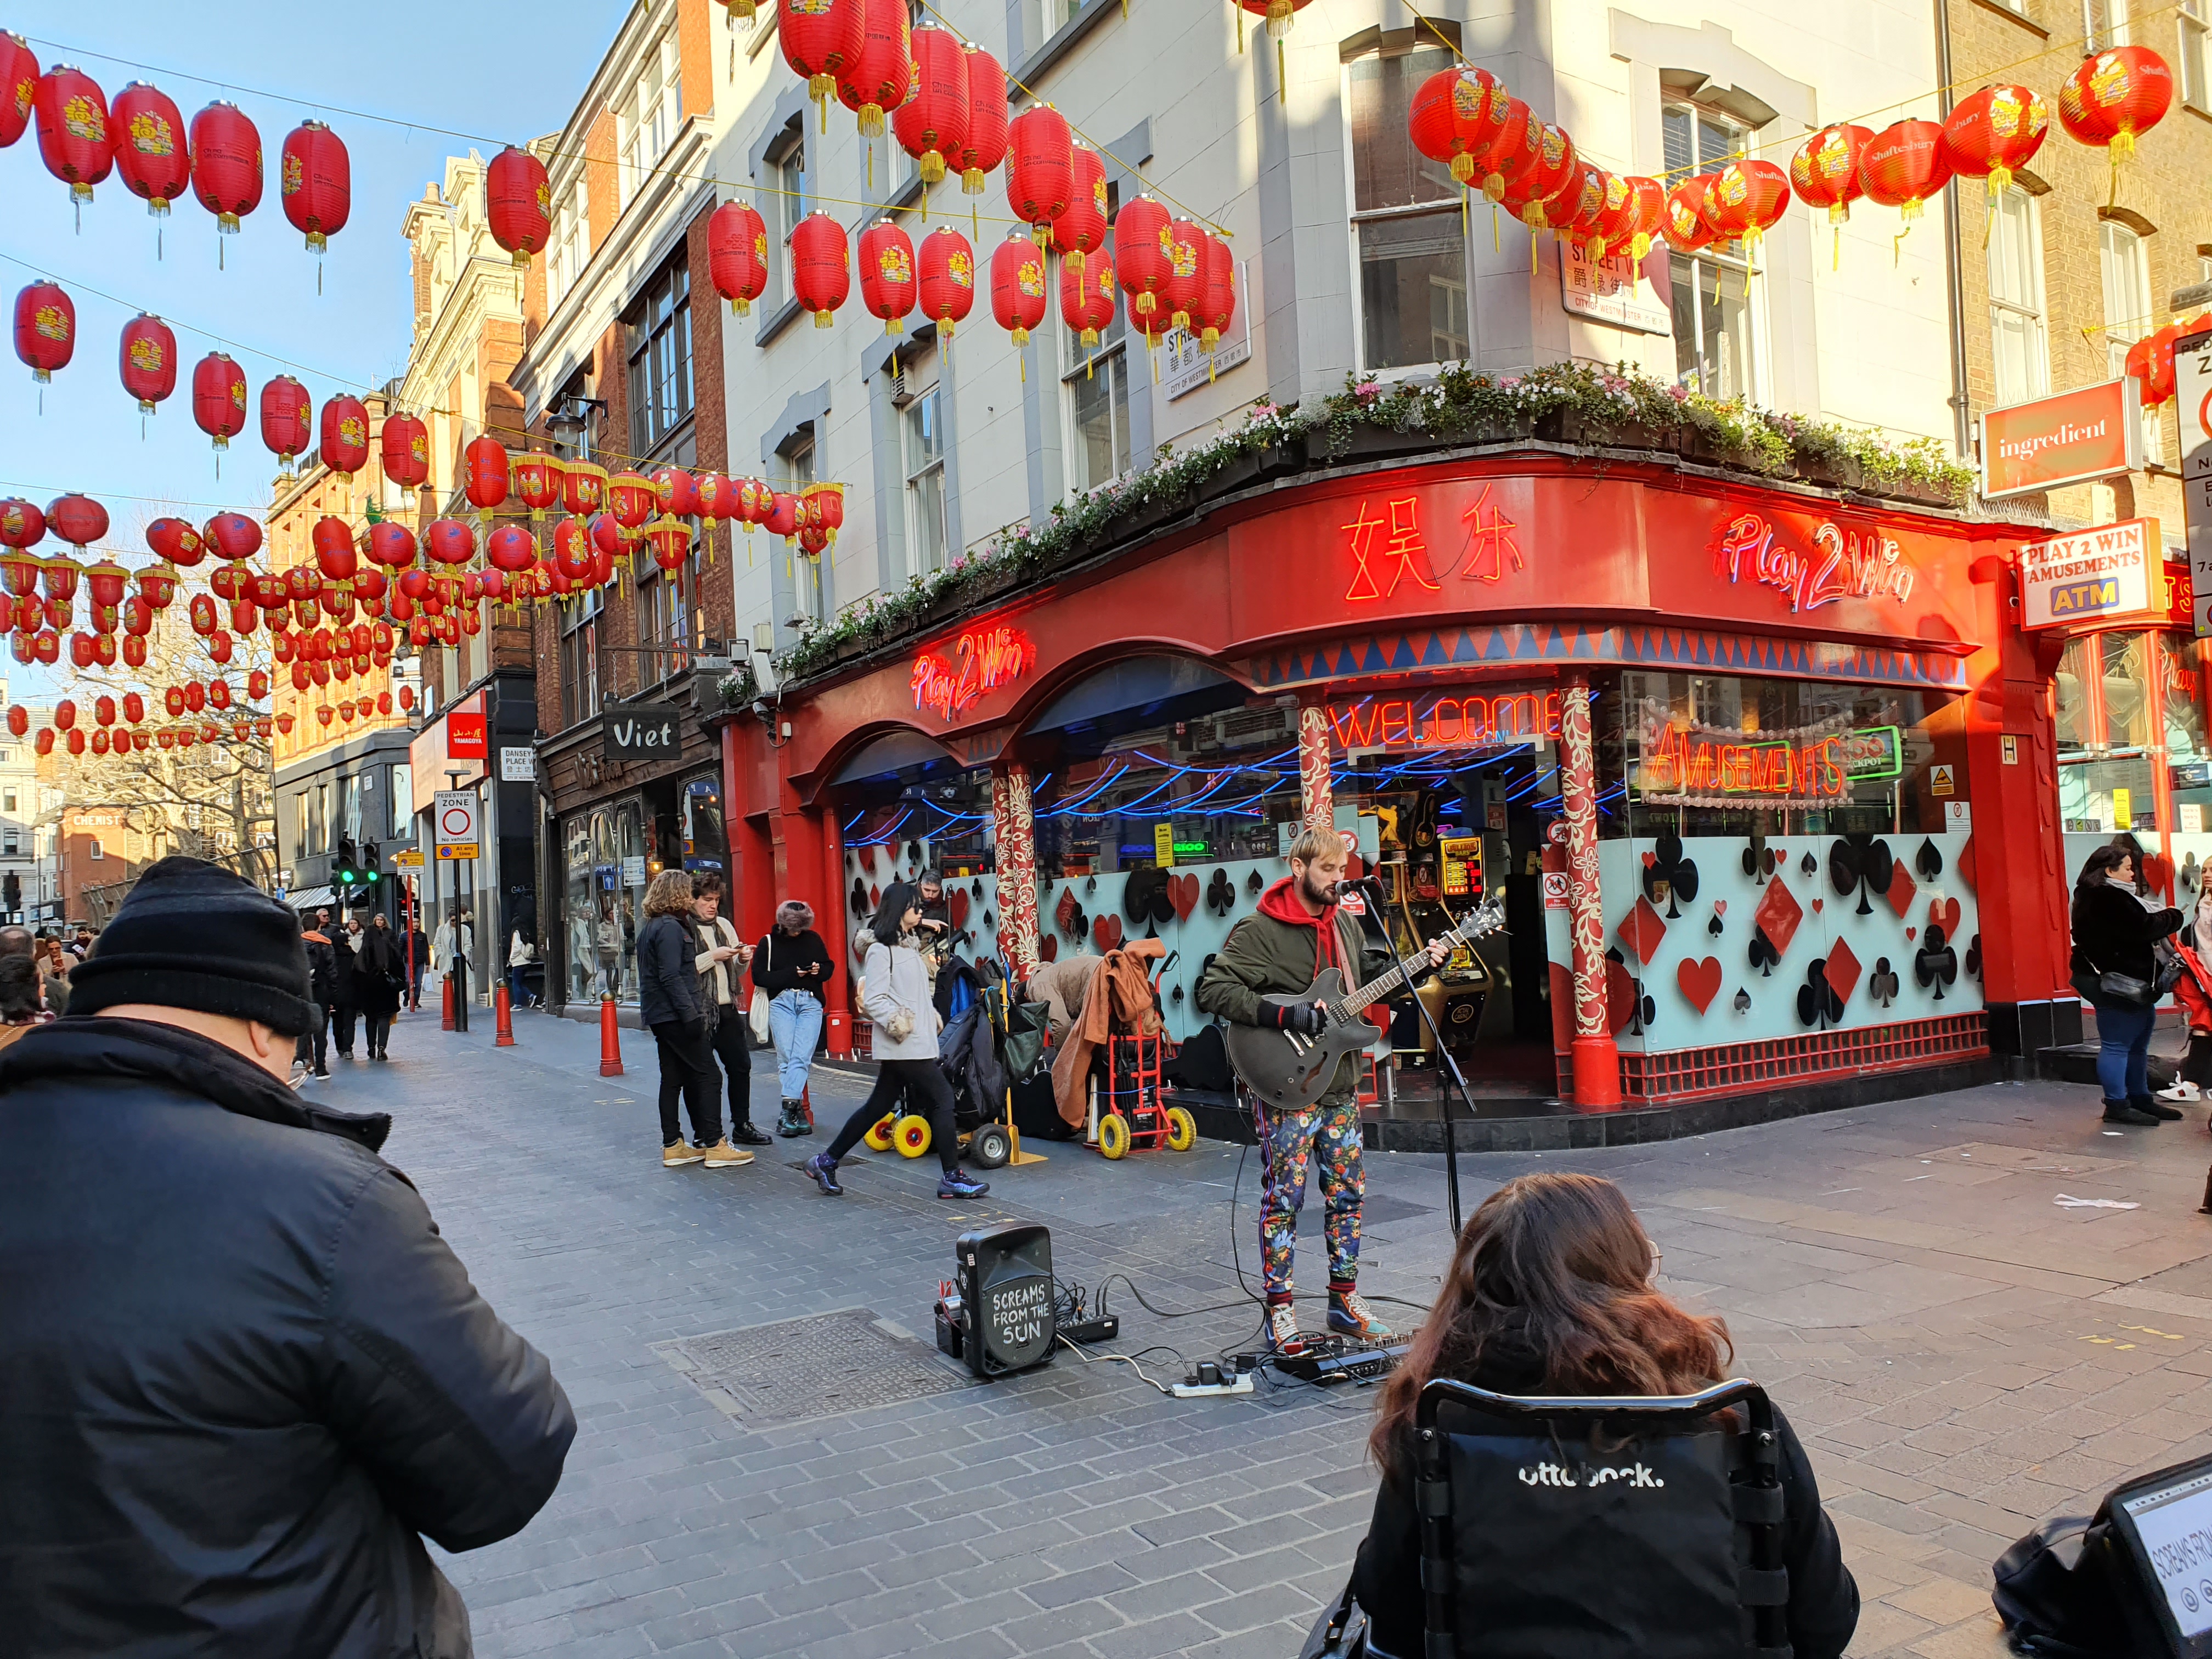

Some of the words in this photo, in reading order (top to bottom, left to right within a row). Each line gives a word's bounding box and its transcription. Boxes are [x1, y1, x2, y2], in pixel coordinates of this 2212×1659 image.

[1572, 244, 1619, 272] STEET
[1575, 297, 1589, 308] CITY
[1590, 302, 1598, 311] OF
[1600, 303, 1641, 321] WESTMISTER
[1171, 382, 1180, 394] CITY
[1182, 378, 1187, 388] OF
[1999, 417, 2107, 461] ingredient
[2027, 540, 2075, 566] PLAY
[2080, 540, 2092, 556] 2
[2096, 528, 2139, 552] WIN
[1720, 514, 1809, 614] Play
[1807, 523, 1847, 610] 2
[1848, 531, 1913, 607] Win
[2028, 550, 2141, 584] AMUSEMENTS
[2053, 580, 2116, 612] ATM
[911, 655, 956, 723] Play
[956, 633, 977, 711] 2
[977, 627, 1024, 687] Win
[613, 717, 672, 748] Viet
[1328, 693, 1560, 748] WELCOME
[1650, 722, 1842, 797] AMUSEMENTS
[73, 815, 121, 826] CHEMIST
[992, 1283, 1046, 1311] SCREAMS
[993, 1308, 1028, 1328] FROM
[1028, 1301, 1050, 1319] THE
[1003, 1320, 1041, 1345] SUN
[2152, 1537, 2198, 1580] SCREAMS
